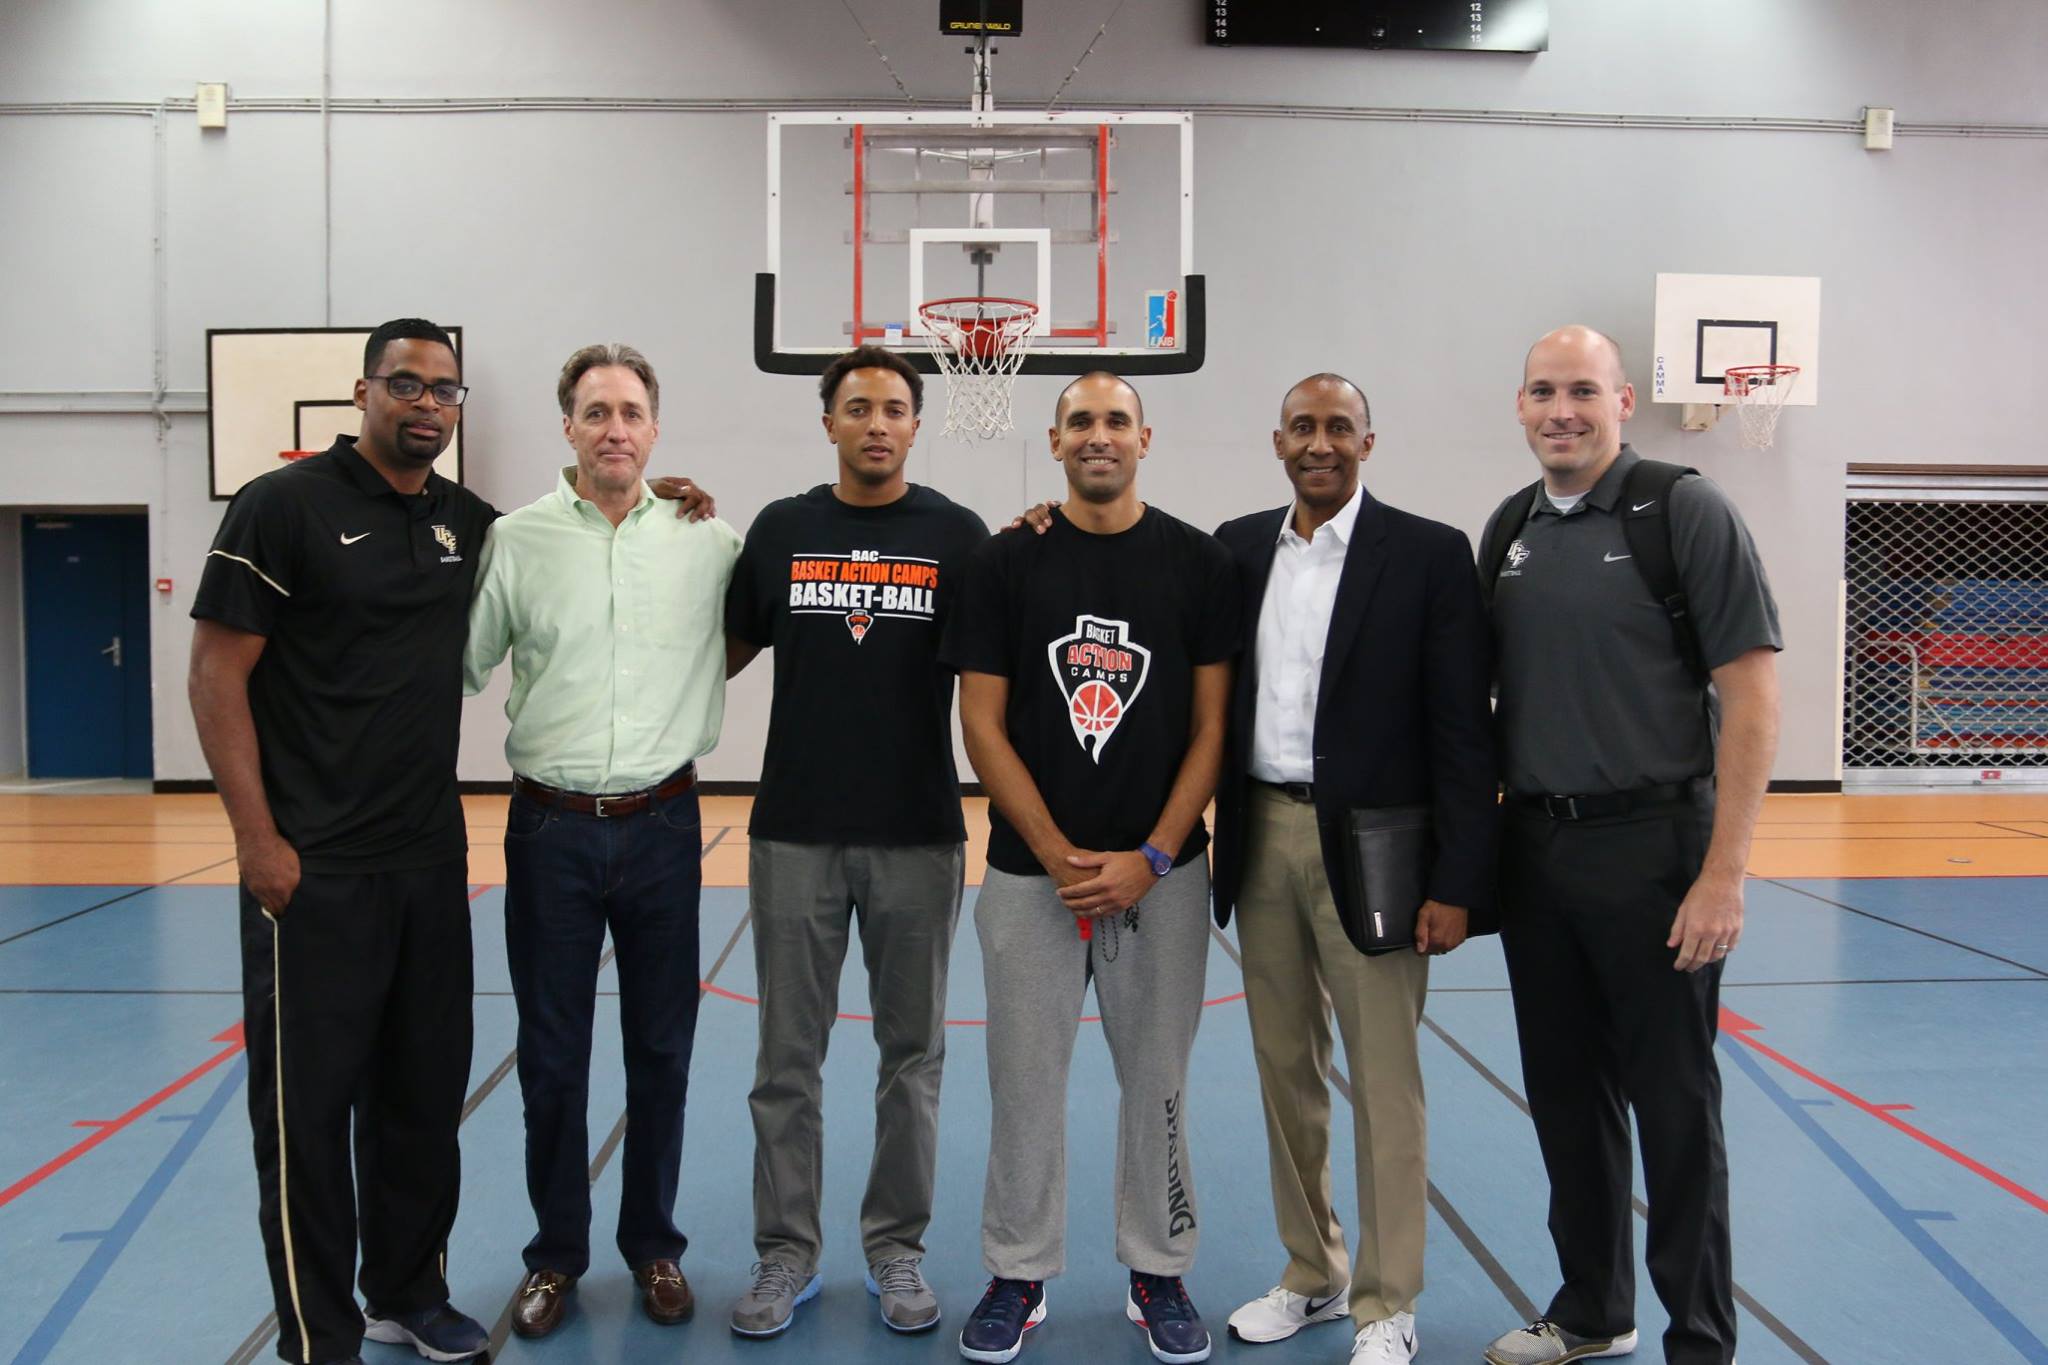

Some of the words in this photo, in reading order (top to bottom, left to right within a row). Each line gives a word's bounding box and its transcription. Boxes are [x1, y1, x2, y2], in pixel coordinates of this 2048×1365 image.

[1216, 8, 1227, 16] 13
[1470, 2, 1481, 11] 12
[1470, 13, 1481, 21] 13
[1215, 29, 1227, 37] 15
[1470, 24, 1481, 32] 14
[1470, 34, 1481, 43] 15
[1150, 336, 1175, 347] LNB
[1656, 356, 1664, 394] CAMMA
[851, 550, 879, 562] BAC
[791, 561, 838, 581] BASKET
[839, 562, 890, 584] ACTION
[892, 564, 938, 589] CAMPS
[789, 582, 935, 614] BASKET-BALL
[1086, 624, 1116, 644] BASKET
[1067, 643, 1132, 671] ACTION
[1071, 666, 1128, 683] CAMPS
